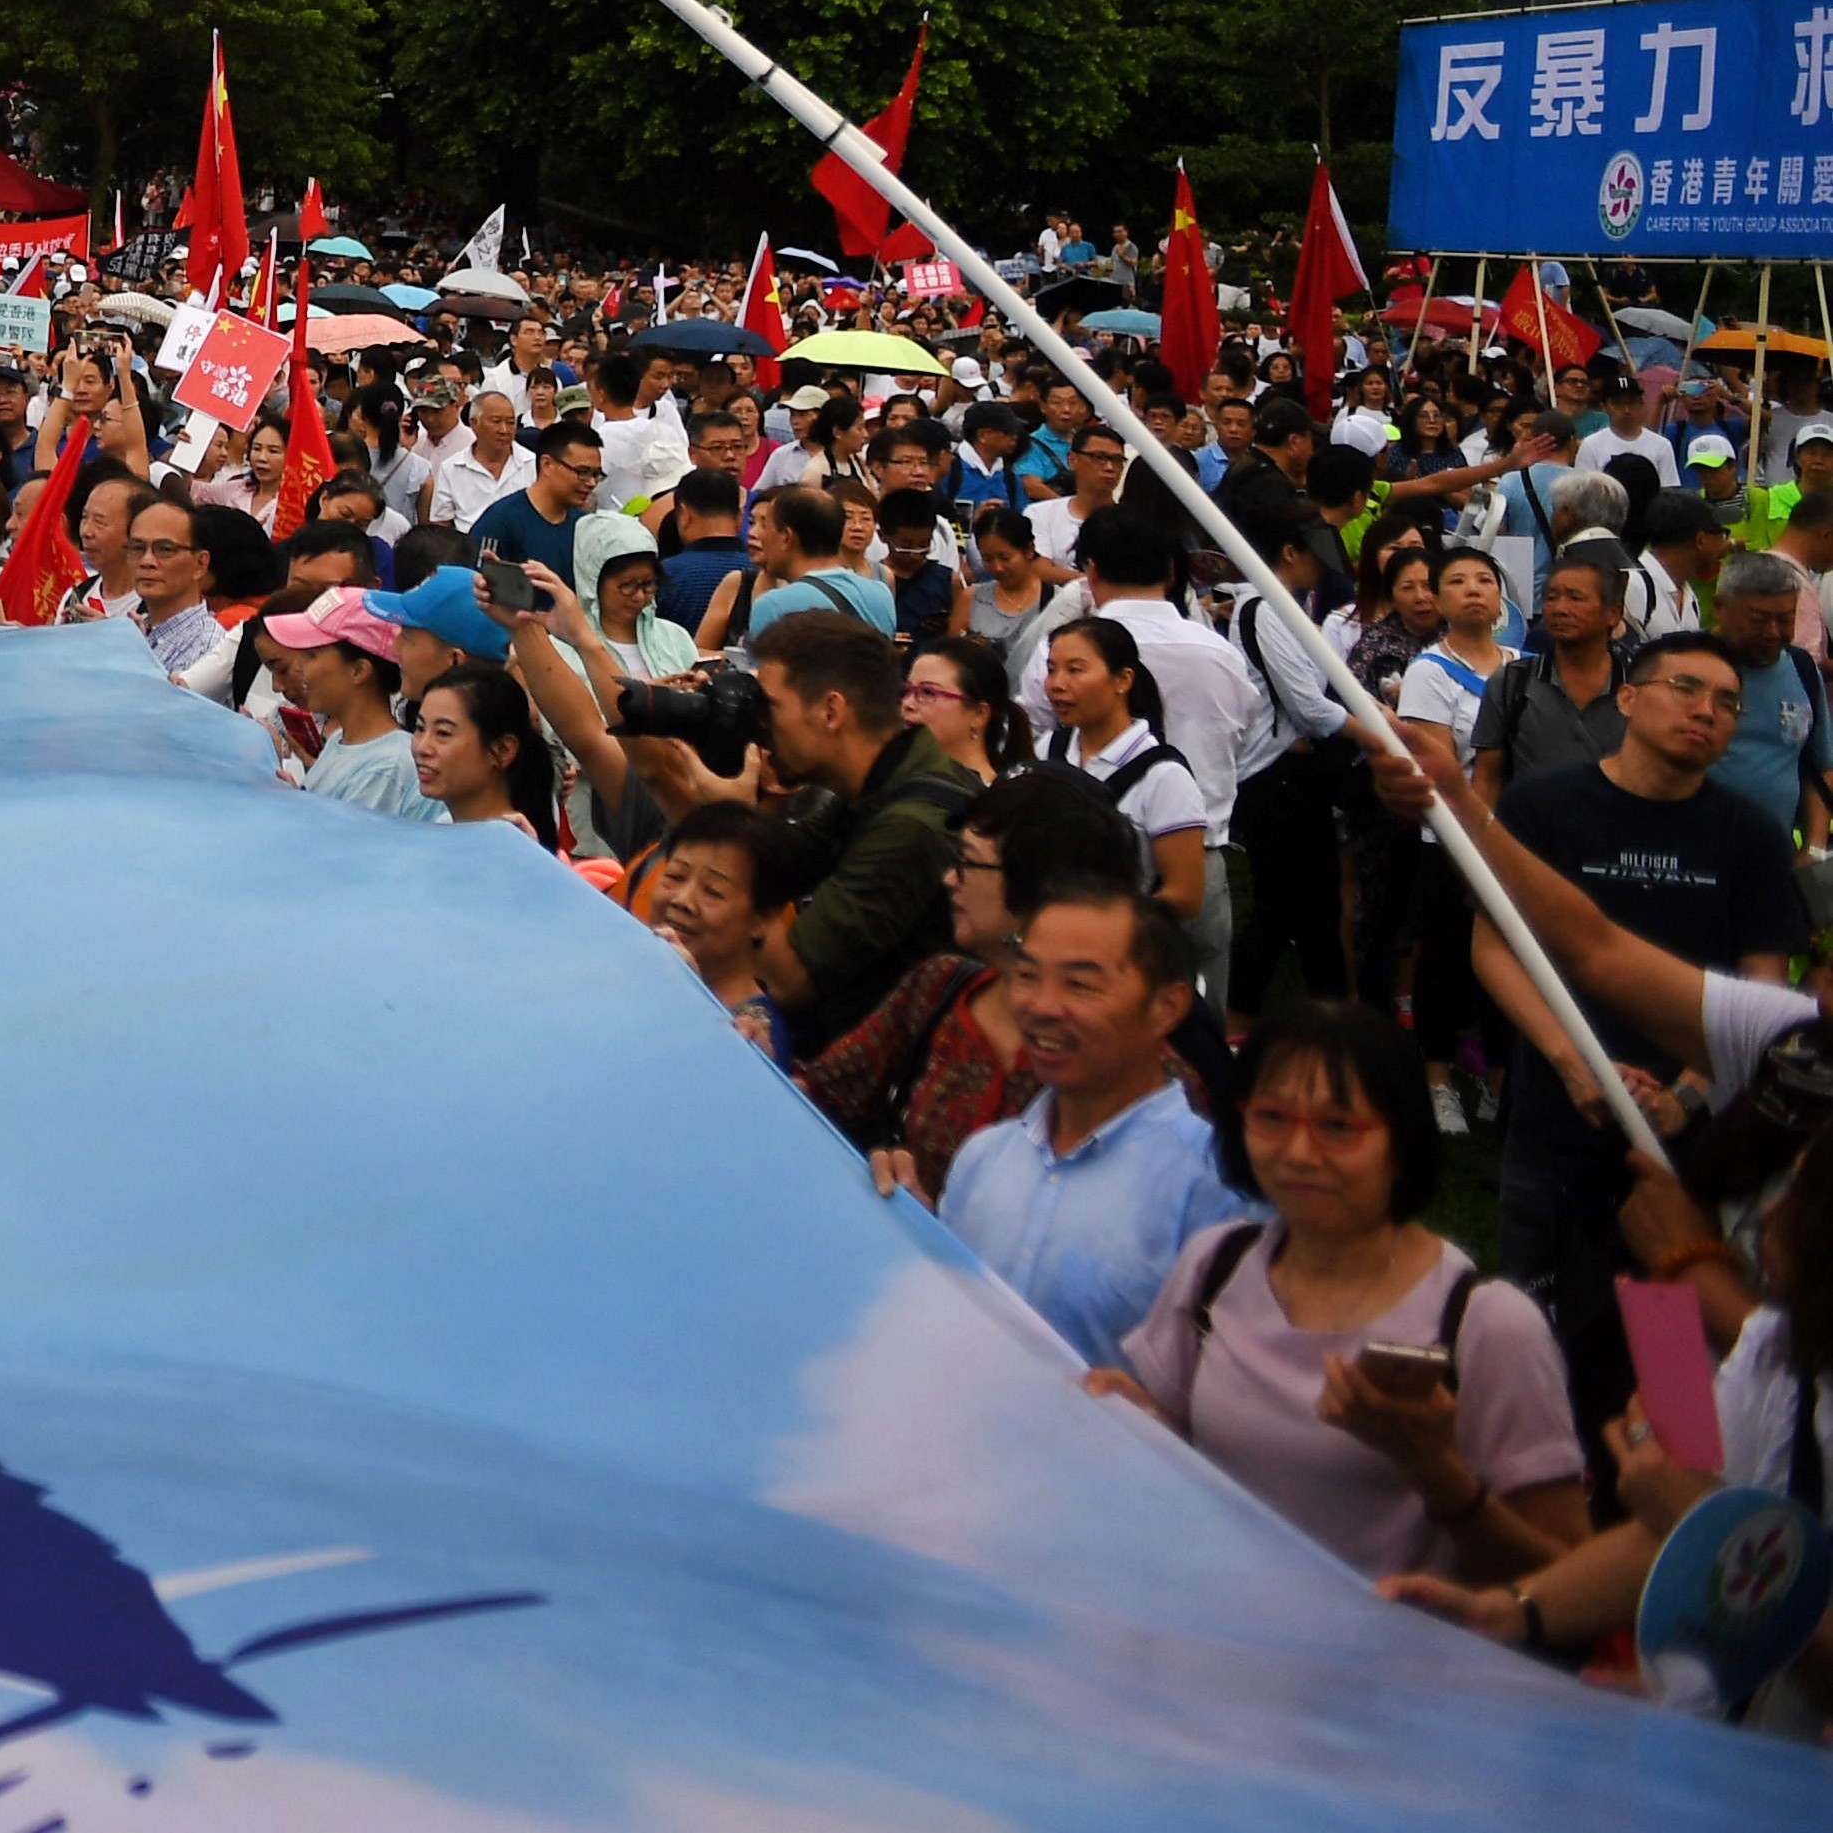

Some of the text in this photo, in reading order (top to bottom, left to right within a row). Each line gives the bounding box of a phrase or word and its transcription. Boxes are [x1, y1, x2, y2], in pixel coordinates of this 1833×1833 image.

[1431, 22, 1717, 142] 反暴力
[1650, 156, 1833, 206] 香港青年關愛
[1646, 217, 1670, 232] CARE
[1672, 217, 1690, 232] FOR
[1692, 217, 1710, 232] THE
[1711, 217, 1743, 232] YOUTH
[1745, 217, 1776, 233] GROUP
[1620, 852, 1679, 870] HILFIGER
